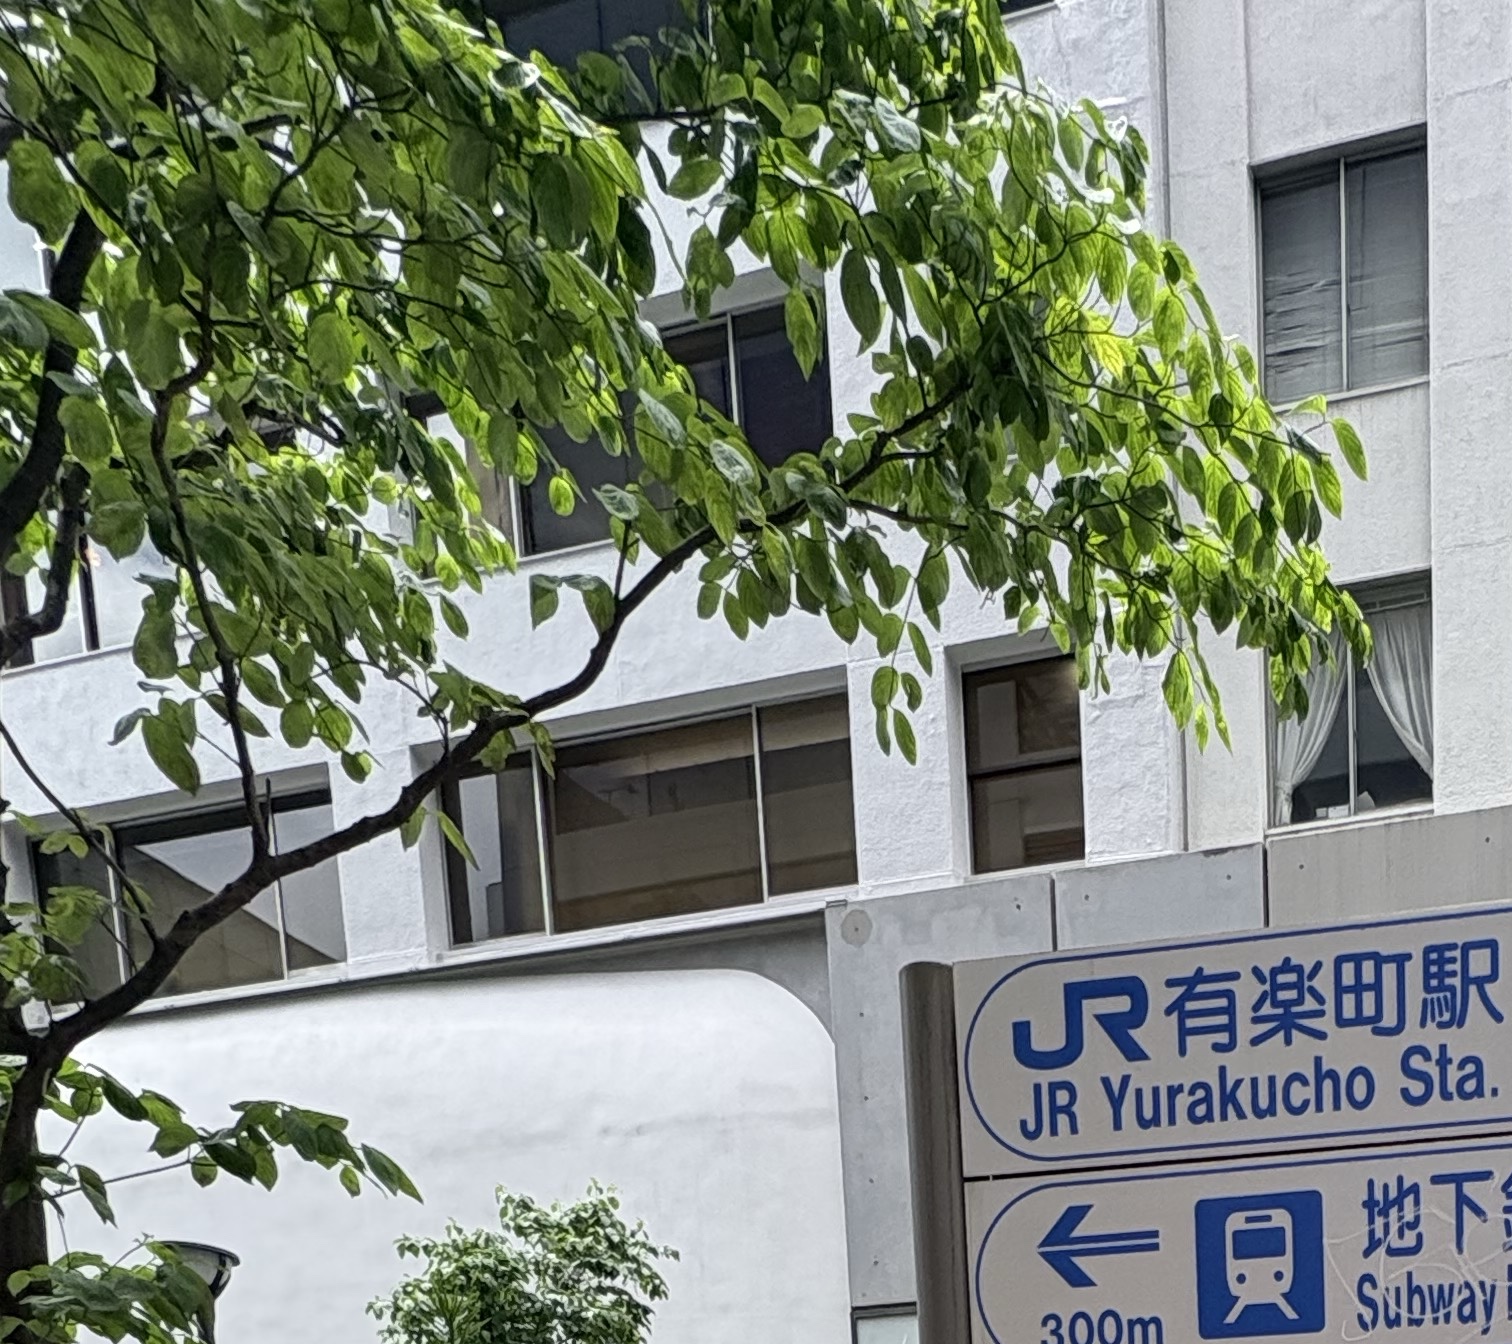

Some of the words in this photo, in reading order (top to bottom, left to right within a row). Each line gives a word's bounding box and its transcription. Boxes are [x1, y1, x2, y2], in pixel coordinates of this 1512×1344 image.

[1019, 1080, 1079, 1141] JR
[1102, 1056, 1376, 1130] Yurakucho
[1400, 1043, 1500, 1106] Sta.
[1356, 1271, 1497, 1334] Subway
